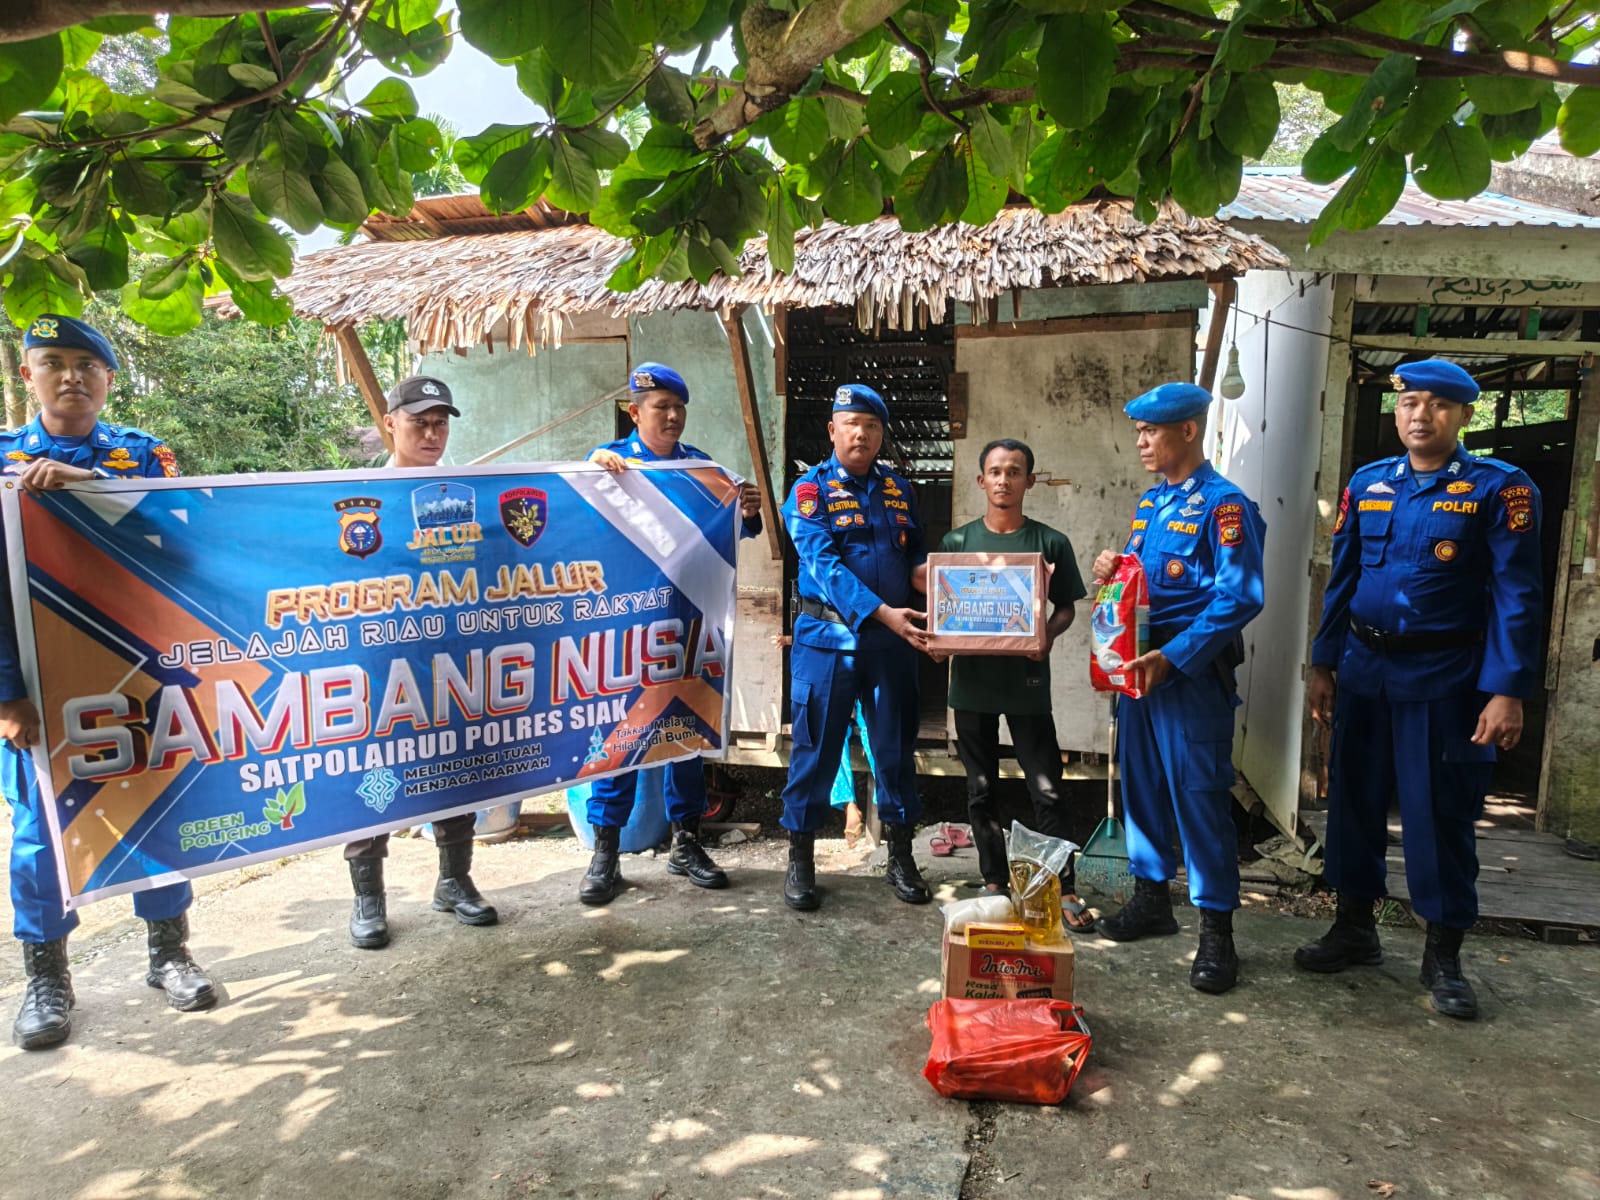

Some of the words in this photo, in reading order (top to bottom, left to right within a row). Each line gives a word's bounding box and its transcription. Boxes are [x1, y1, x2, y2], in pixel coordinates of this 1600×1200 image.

[339, 500, 377, 509] RIAU
[1432, 501, 1478, 514] POLRI
[1509, 499, 1529, 507] RIAU
[406, 523, 483, 550] JALUR
[1167, 521, 1199, 535] POLRI
[266, 568, 479, 629] PROGRAM
[487, 560, 608, 601] JALUR
[939, 601, 994, 616] SAMBANG
[996, 602, 1028, 617] NUSA
[159, 627, 348, 668] JELAJAH
[362, 615, 445, 643] RIAU
[458, 600, 563, 633] UNTUK
[574, 588, 672, 621] RAKYAT
[62, 640, 536, 782] SAMBANG
[551, 616, 727, 705] NUSA
[615, 725, 651, 738] Takkan
[655, 714, 696, 730] Melayu
[239, 728, 466, 793] SATPOLAIRUD
[469, 711, 563, 750] POLRES
[570, 694, 628, 729] SIAK
[613, 740, 649, 752] Hilang
[651, 735, 662, 745] di
[665, 727, 697, 742] Bumi
[404, 752, 501, 779] MELINDUNGI
[504, 743, 542, 762] TUAH
[404, 772, 480, 797] MENJAGA
[482, 757, 550, 778] MARWAH
[179, 811, 243, 836] GREEN
[180, 823, 271, 852] POLICING
[965, 981, 998, 989] Rasa
